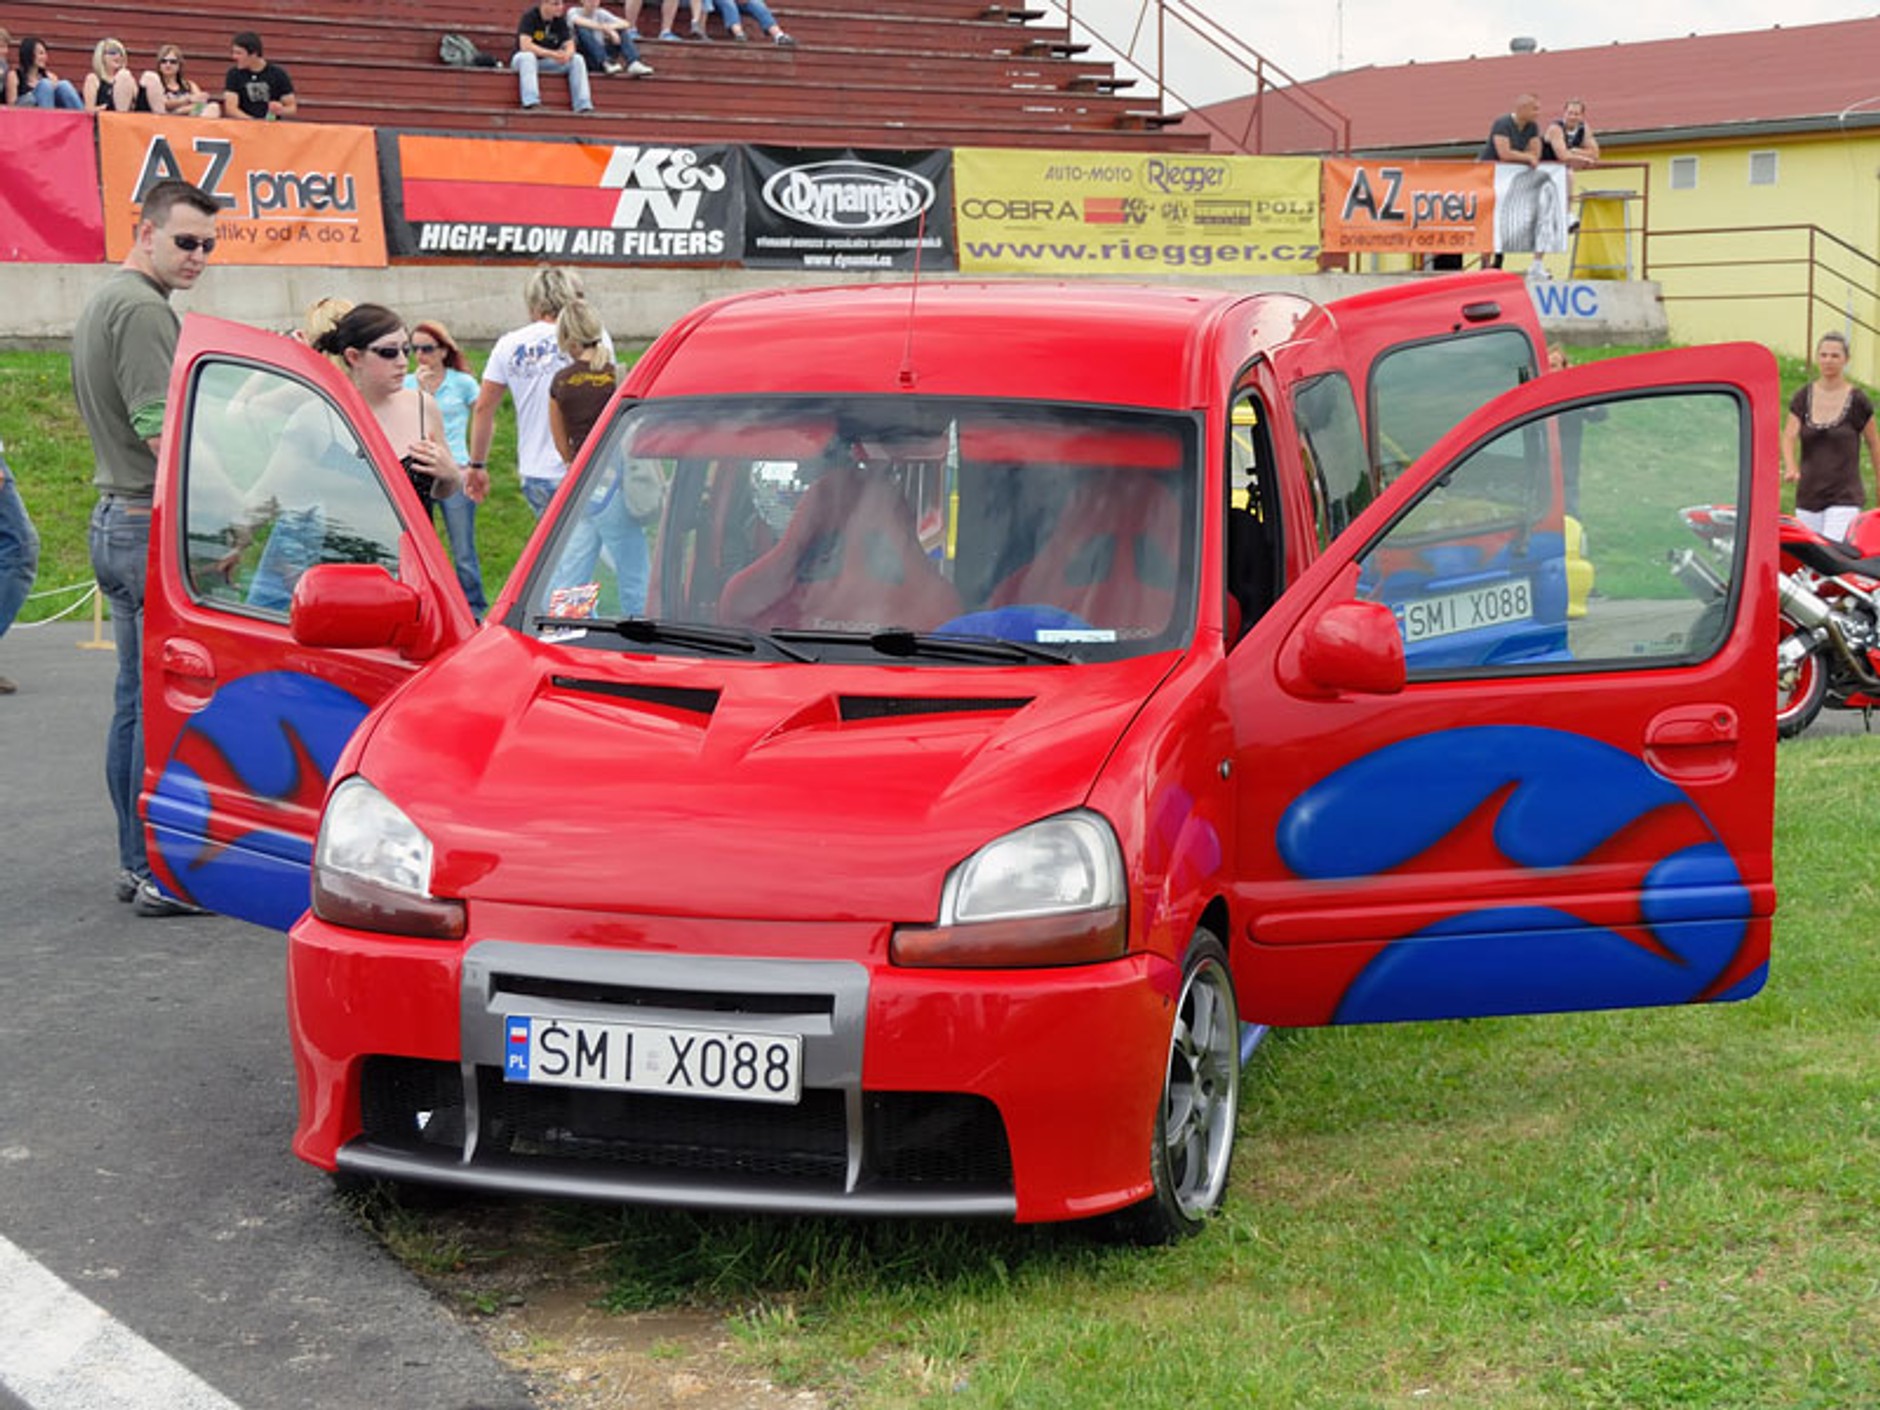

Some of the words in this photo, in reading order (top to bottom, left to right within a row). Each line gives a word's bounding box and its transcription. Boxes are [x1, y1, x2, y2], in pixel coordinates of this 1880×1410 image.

[1147, 160, 1225, 193] Riegger
[247, 169, 358, 218] pneu
[789, 171, 914, 222] Dynamat
[960, 199, 1079, 221] COBRA
[1341, 166, 1405, 222] AZ
[1411, 188, 1477, 228] pneu
[267, 226, 293, 242] od
[298, 224, 312, 241] A
[318, 225, 345, 243] do
[419, 223, 568, 254] HIGH-FLOW
[571, 228, 616, 255] AIR
[622, 230, 726, 256] FILTERS
[965, 239, 1320, 266] www.riegger.cz
[1535, 284, 1599, 317] WC
[508, 1054, 528, 1070] PL
[666, 1034, 790, 1093] X088
